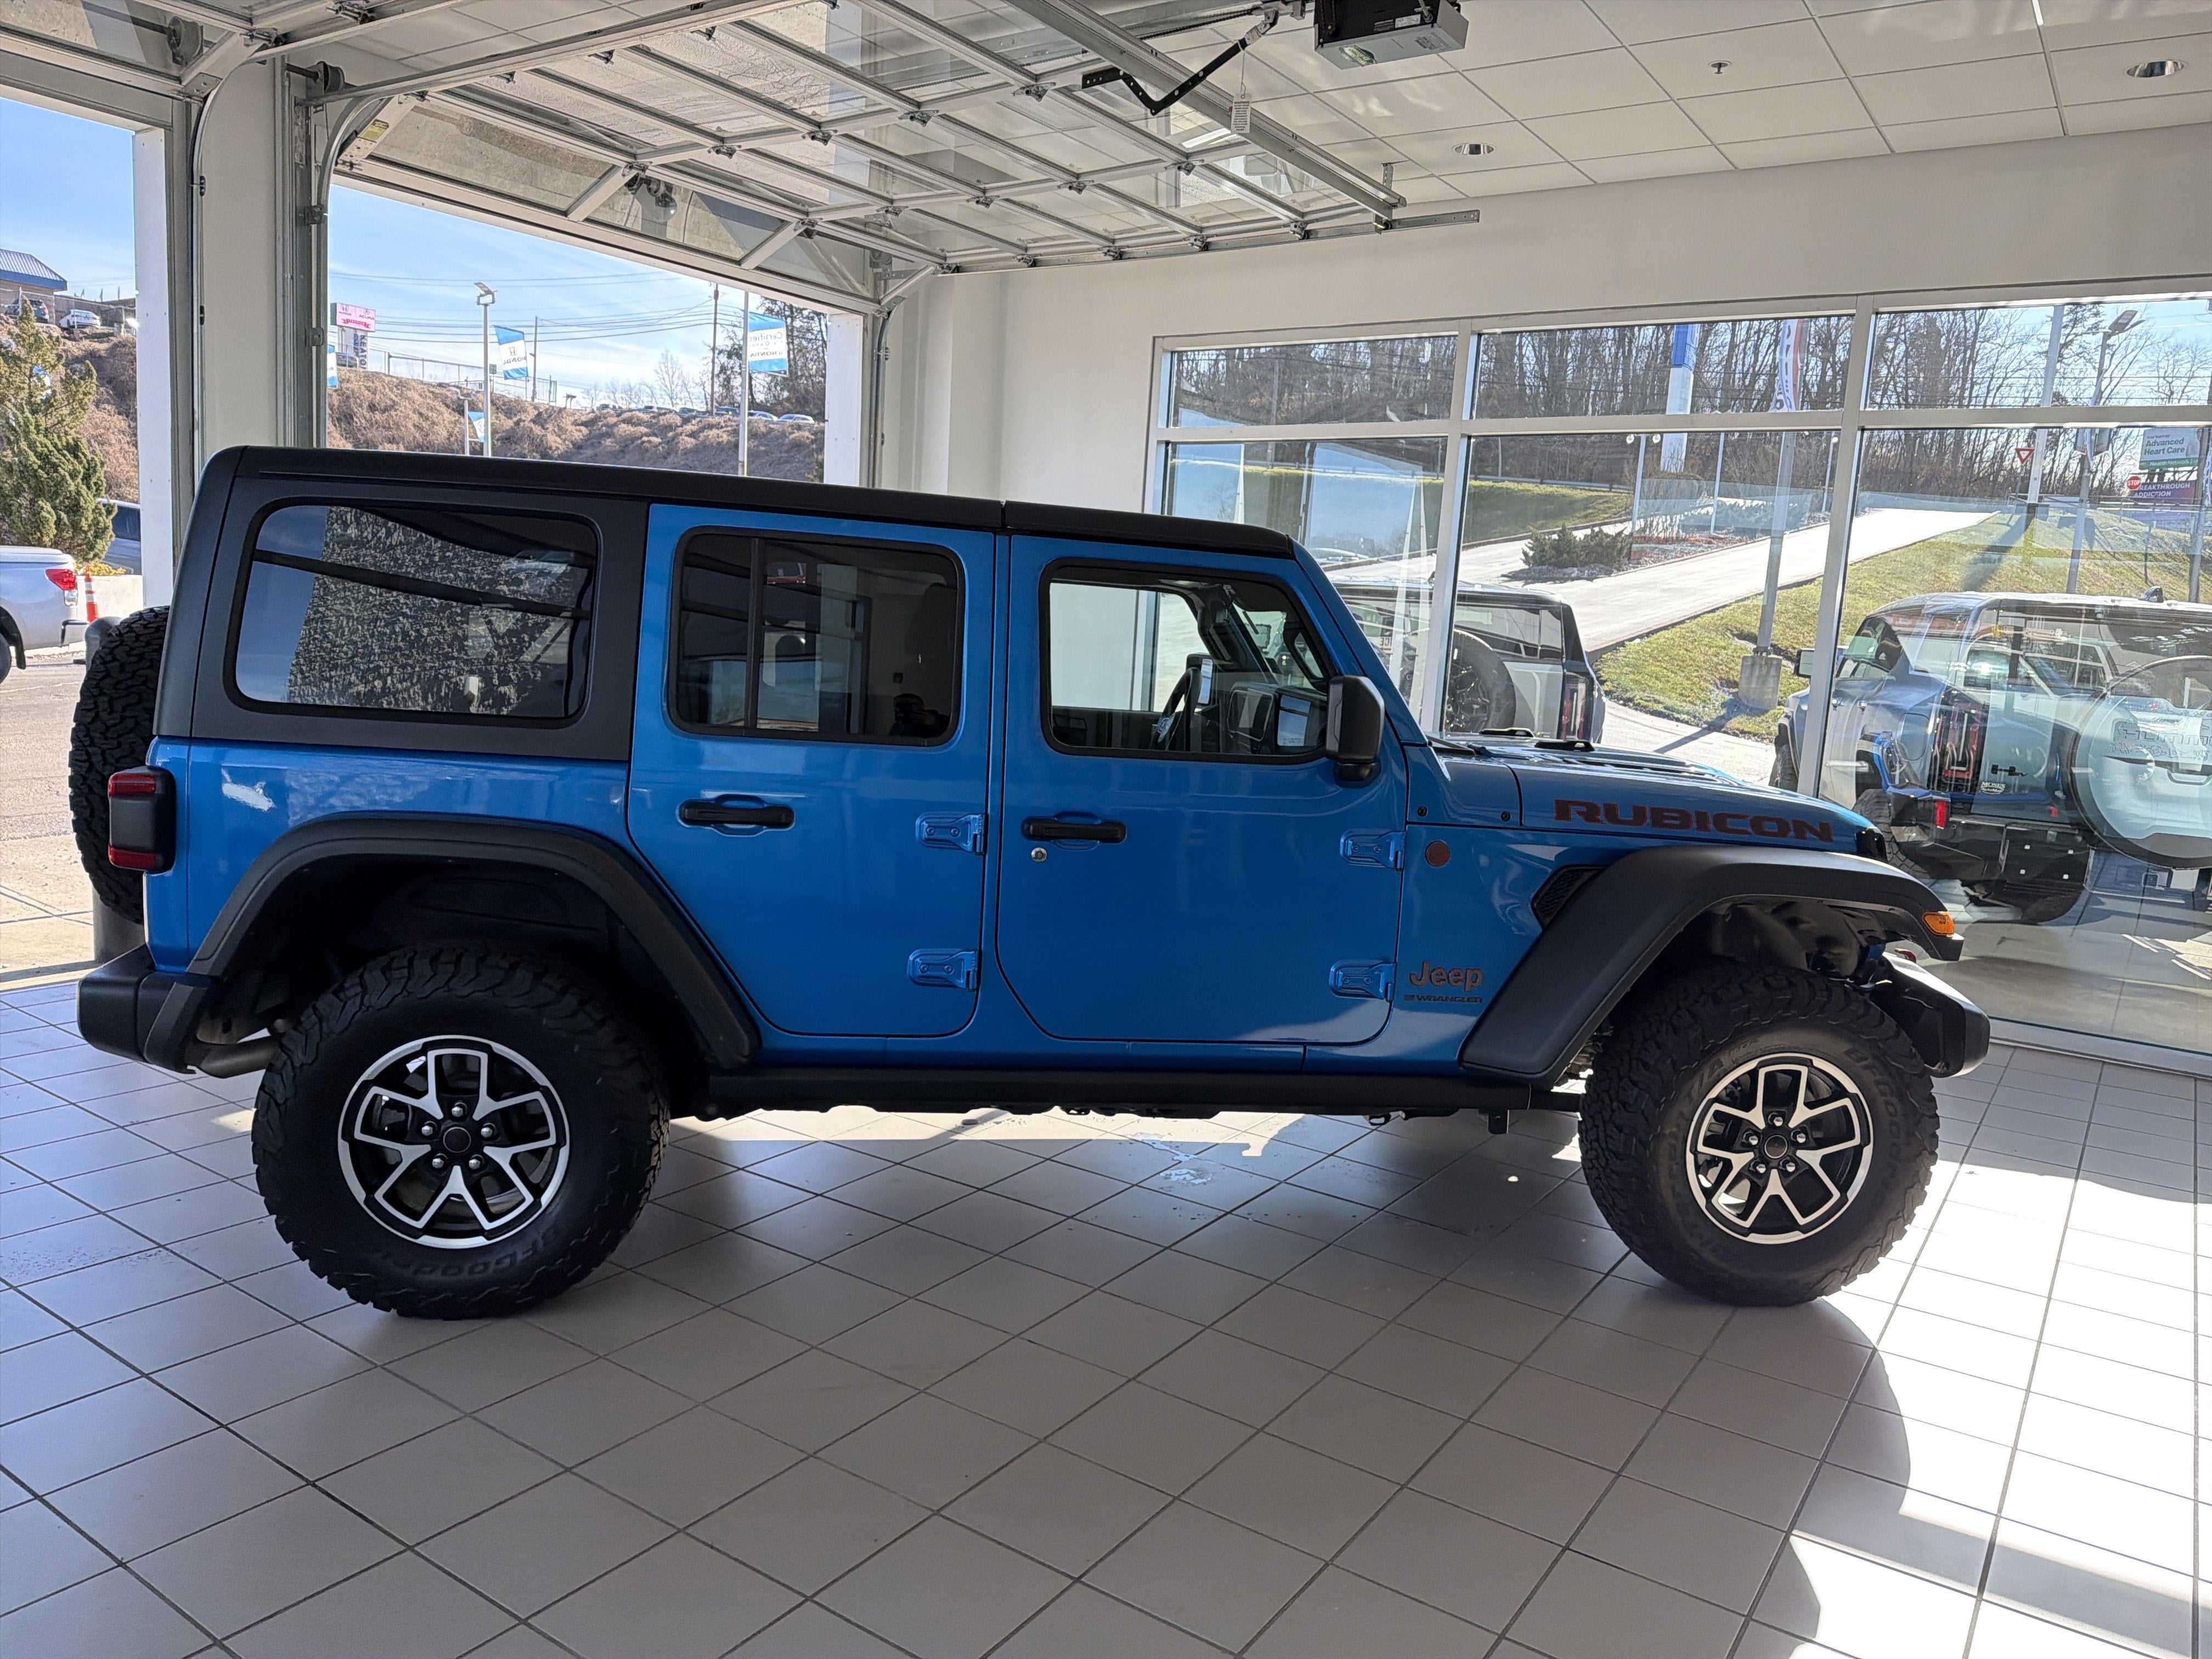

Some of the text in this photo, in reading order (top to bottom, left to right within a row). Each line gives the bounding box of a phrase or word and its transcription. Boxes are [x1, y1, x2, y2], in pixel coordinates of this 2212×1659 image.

[2146, 438, 2185, 447] Advanced
[2144, 447, 2165, 455] Heart
[2139, 482, 2191, 490] REAKTHROUGH
[1554, 798, 1834, 844] RUBICON
[1409, 960, 1485, 992] Jeep
[1417, 995, 1483, 1003] WRANGLER
